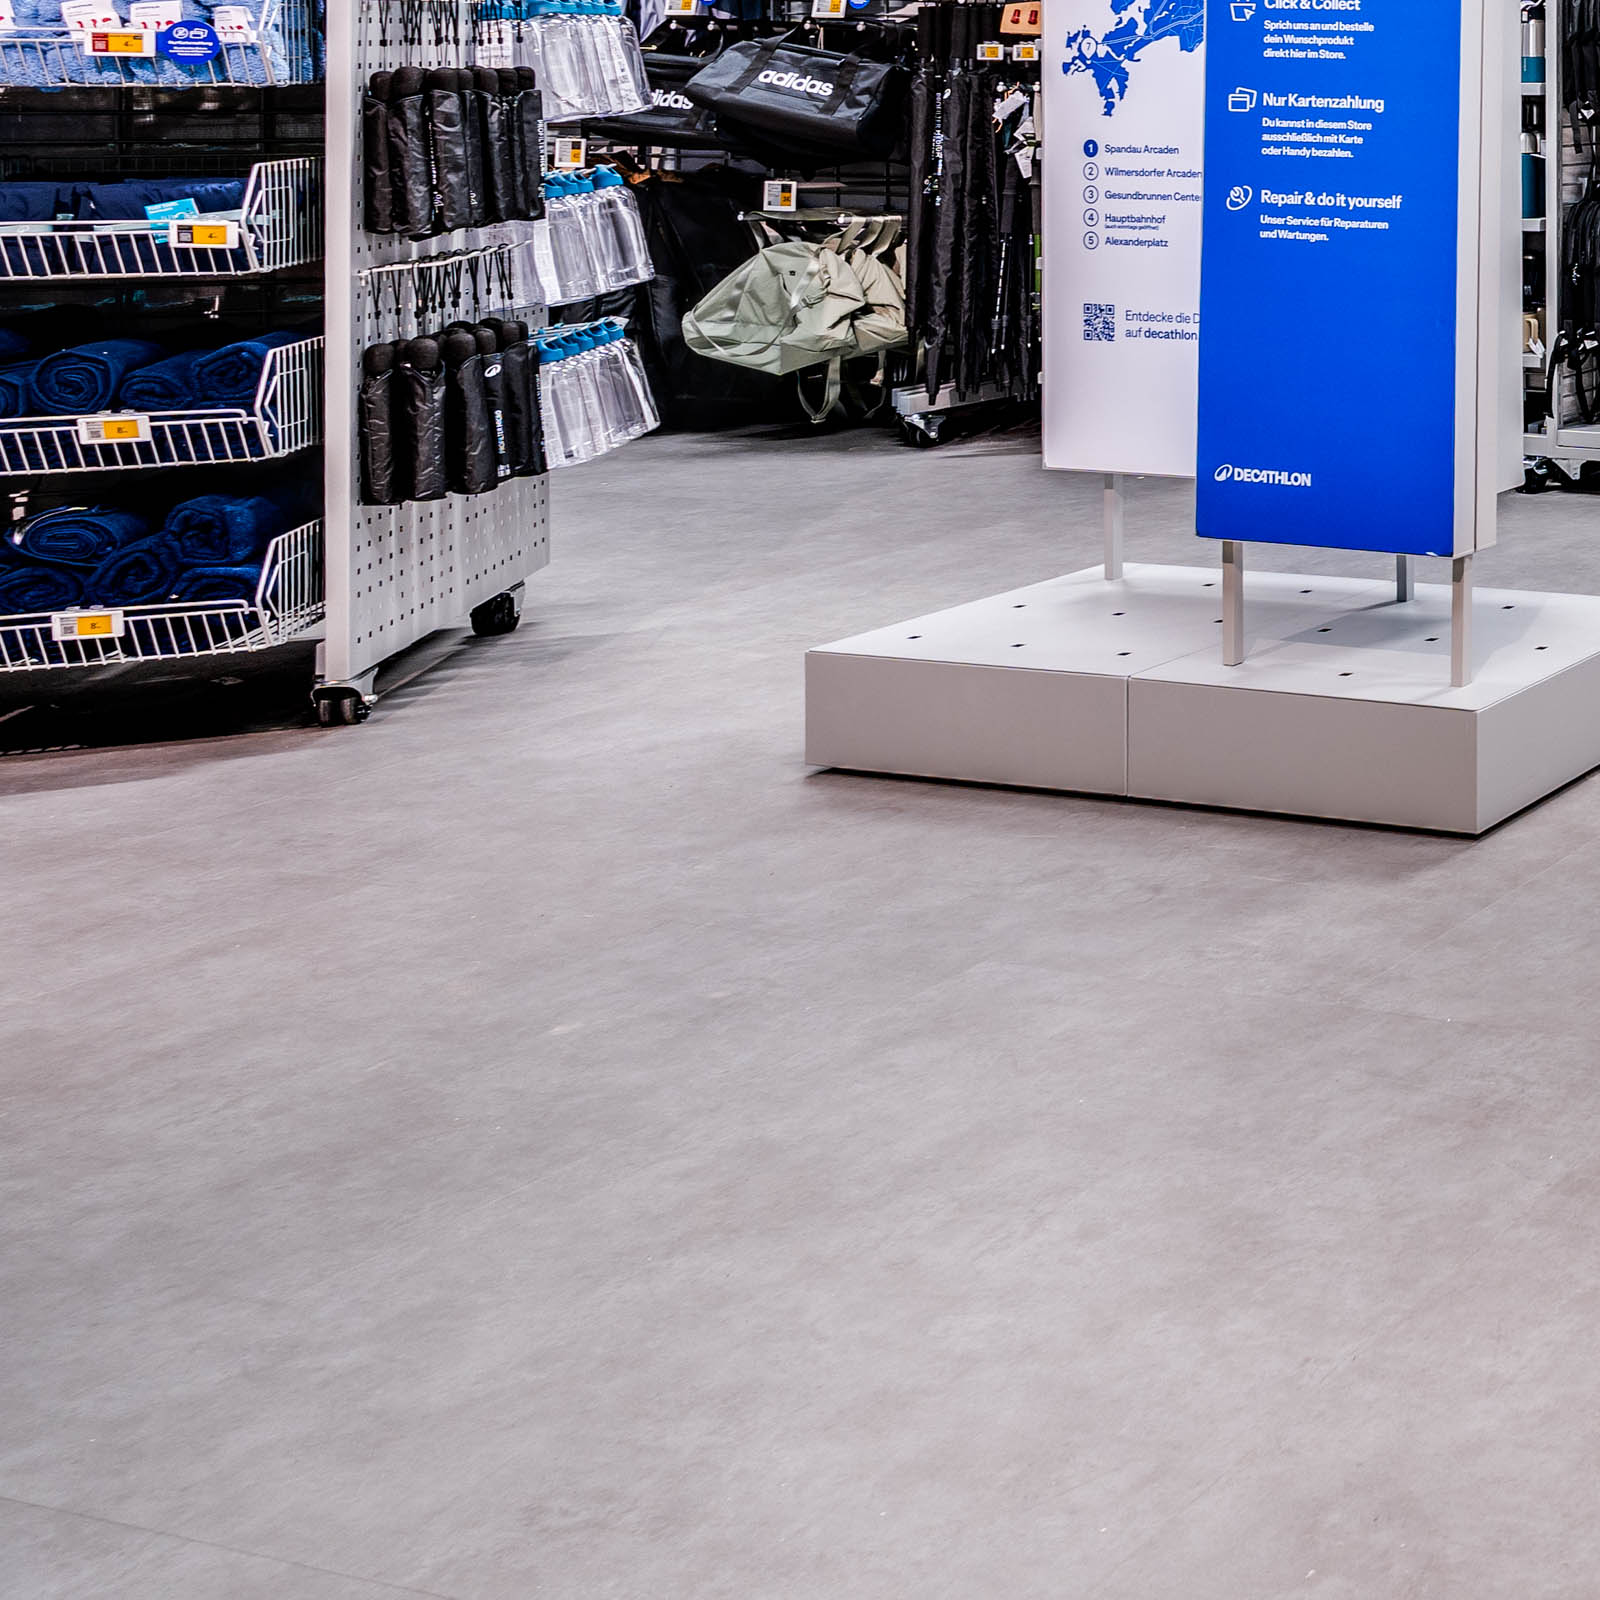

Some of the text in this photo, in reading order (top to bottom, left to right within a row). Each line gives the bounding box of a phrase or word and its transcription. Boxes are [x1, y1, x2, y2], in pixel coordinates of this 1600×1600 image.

[1264, 20, 1374, 32] Sprich uns an und bestelle
[1264, 34, 1354, 46] dein Wunschprodukt
[1264, 48, 1346, 59] direkt hier im Store.
[758, 69, 834, 97] adidas
[651, 89, 694, 110] didas
[1262, 93, 1384, 113] Nur Kartenzahlung
[1262, 118, 1372, 130] Du kannst in diesem Store
[1323, 134, 1338, 143] mit
[1338, 134, 1363, 144] Karte
[1087, 144, 1179, 155] 1 Spandau Arcaden
[1261, 146, 1354, 158] oder Handy bezahlen.
[1088, 167, 1094, 176] 2
[1105, 167, 1165, 178] Wilmersdorfer
[1088, 190, 1094, 199] 3
[1104, 190, 1172, 201] Gesundbrunnen
[1261, 190, 1402, 209] Repair & do it yourself
[1088, 213, 1166, 224] 4 Hauptbahnhof
[1260, 215, 1388, 229] Unser Service für Reparaturen
[1260, 229, 1329, 242] und Wartungen.
[1088, 236, 1168, 248] 5 Alexanderplatz
[1125, 310, 1173, 324] Entdecke
[1175, 311, 1192, 324] die
[1125, 328, 1142, 338] auf
[1233, 467, 1312, 487] DECATHLON
